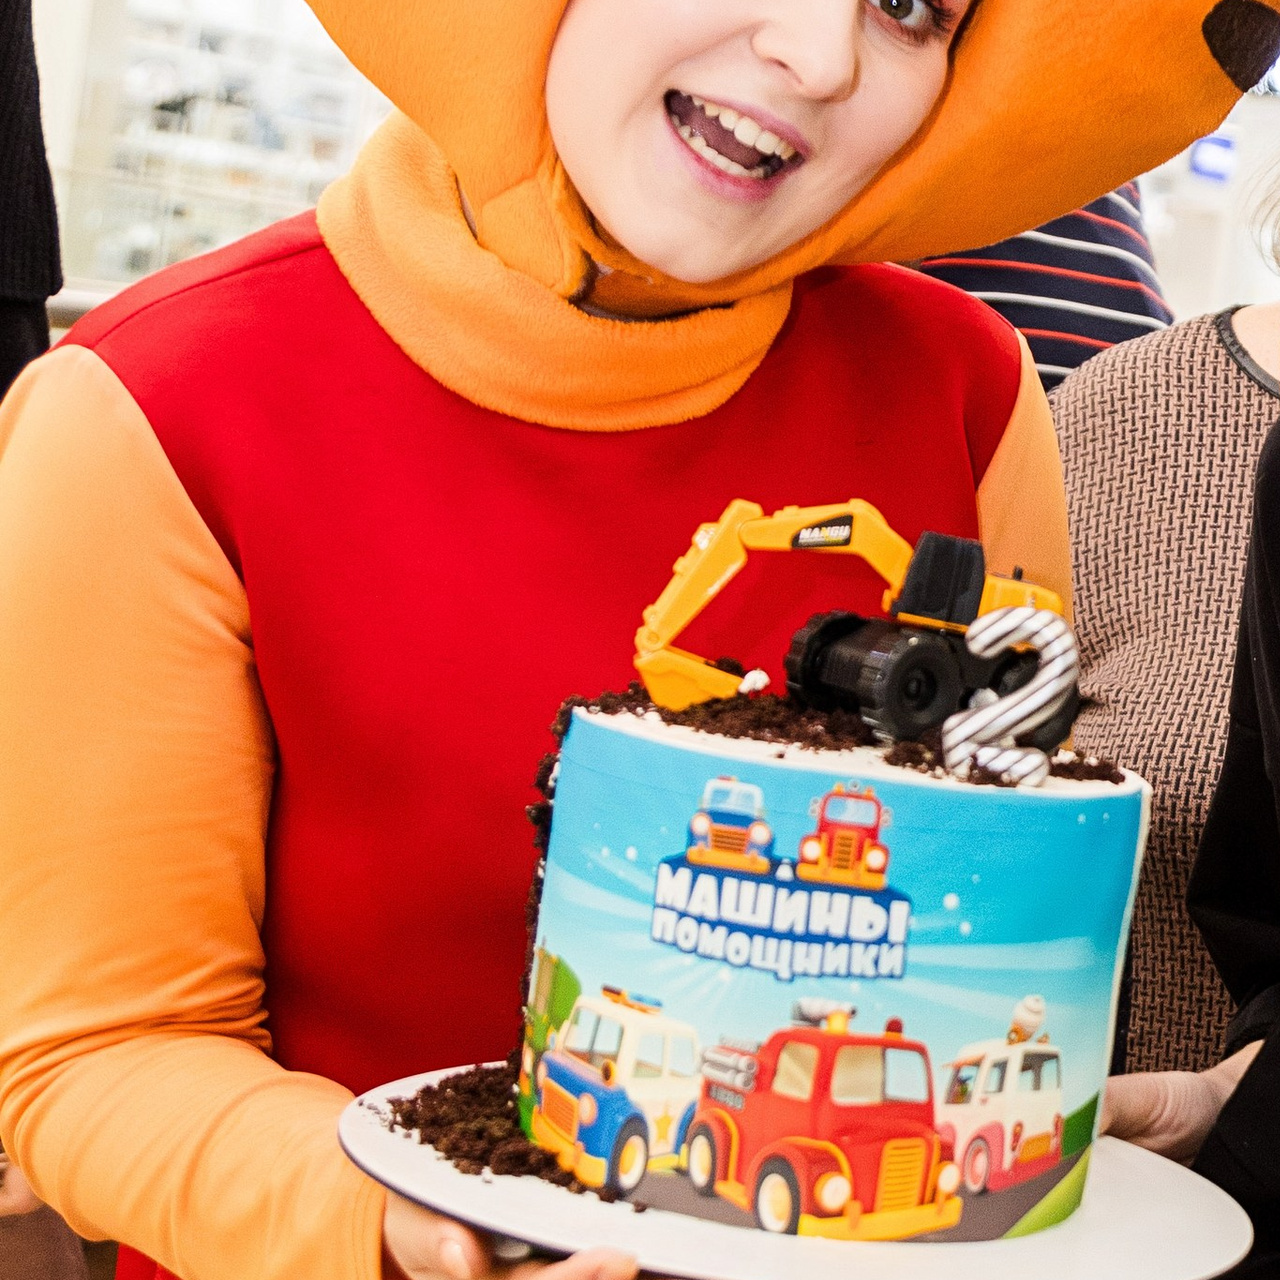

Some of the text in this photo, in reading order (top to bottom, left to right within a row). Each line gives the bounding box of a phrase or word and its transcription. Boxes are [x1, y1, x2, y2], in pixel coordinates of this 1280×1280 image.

[941, 606, 1079, 787] 2
[655, 862, 910, 943] МАШИНЫ
[652, 907, 905, 982] ПОМОЩНИКИ
